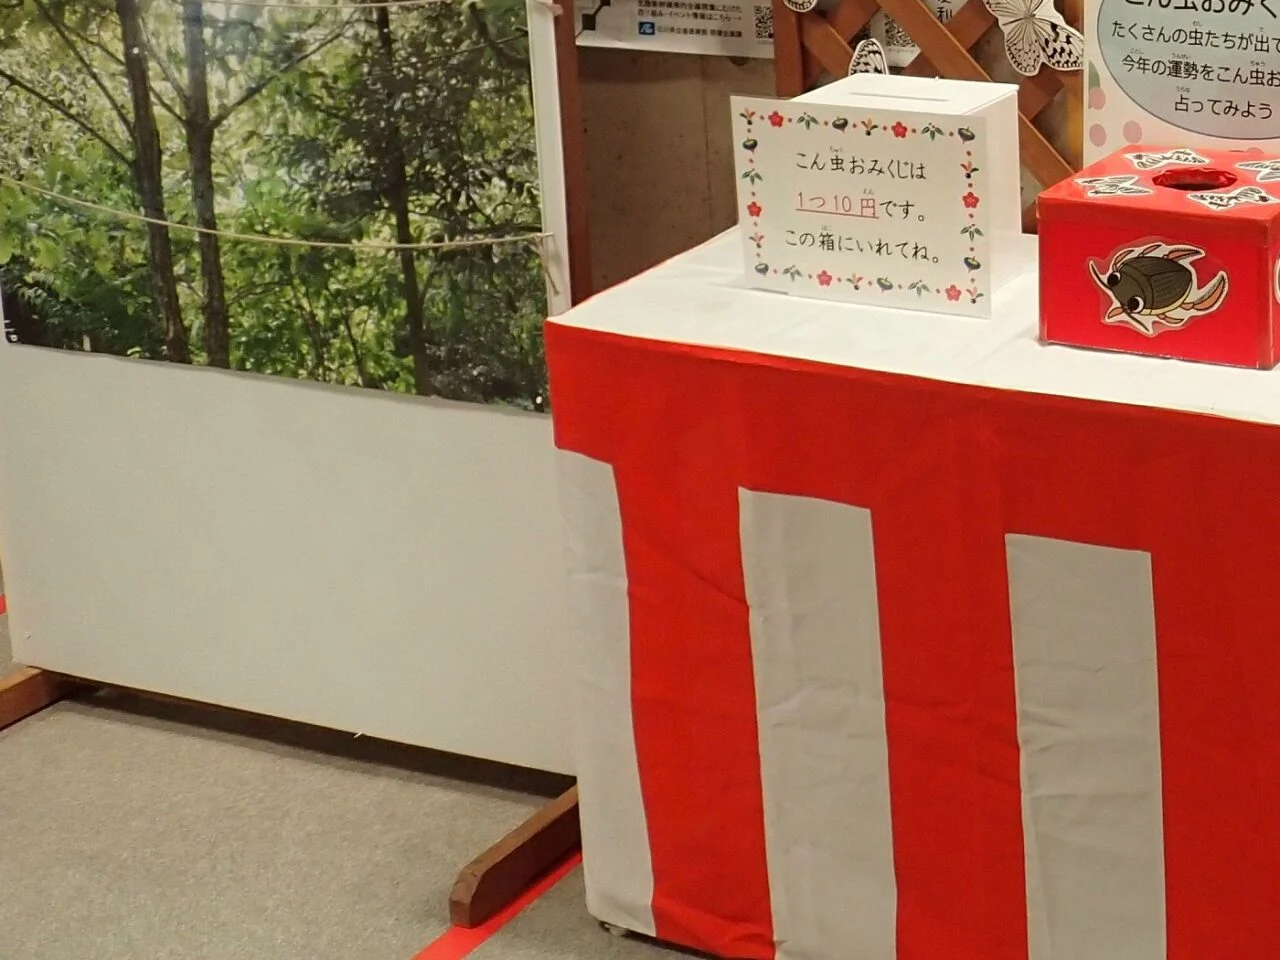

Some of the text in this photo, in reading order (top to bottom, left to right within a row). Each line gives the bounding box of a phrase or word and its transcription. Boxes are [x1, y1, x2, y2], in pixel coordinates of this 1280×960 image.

[795, 152, 927, 180] こん虫おみくじは
[785, 229, 939, 264] この箱にいれてね。
